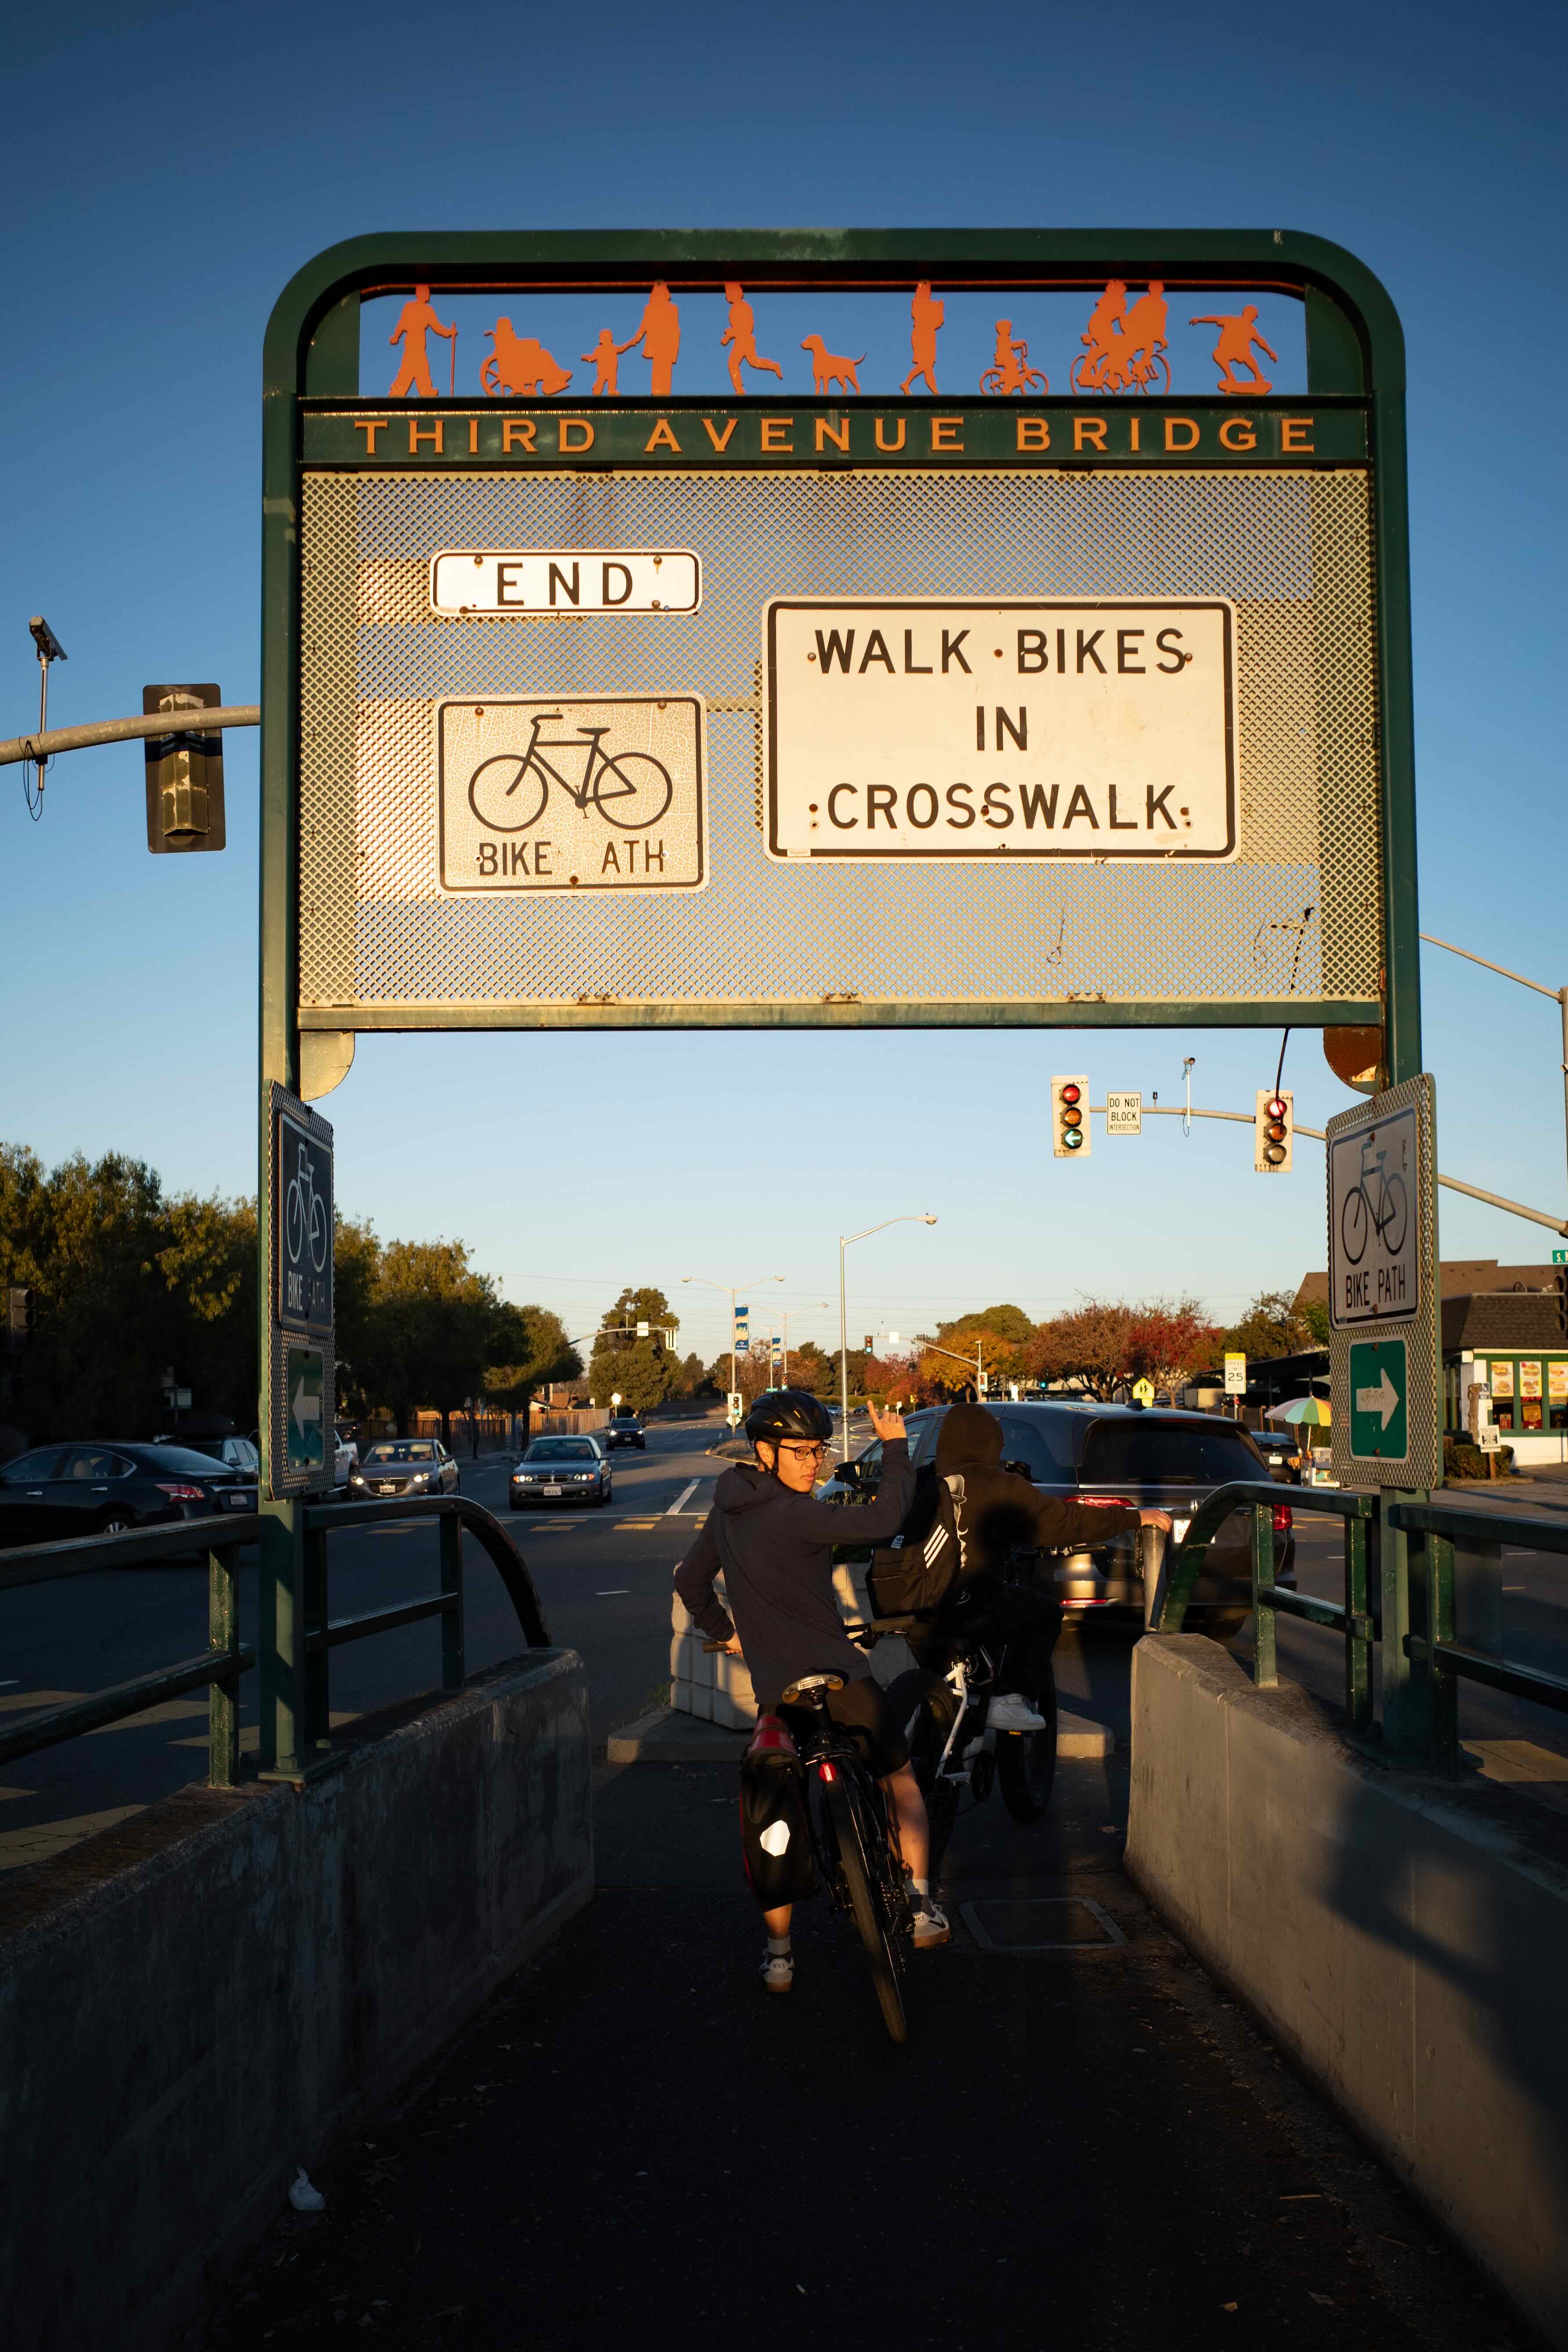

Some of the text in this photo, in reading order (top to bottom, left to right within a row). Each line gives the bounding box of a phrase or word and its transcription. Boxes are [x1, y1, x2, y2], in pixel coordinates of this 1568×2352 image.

[354, 417, 1315, 454] THIRD AVENUE BRIDGE
[497, 562, 633, 605] END
[815, 628, 1185, 674] WALK BIKES
[976, 705, 1027, 751] IN
[828, 783, 1177, 830] CROSSWALK
[479, 841, 553, 876] BIKE
[1109, 1098, 1139, 1107] DO NOT
[1111, 1112, 1137, 1121] BLOCK
[288, 1270, 303, 1311] BIKE
[1346, 1263, 1405, 1308] BIKE PATH
[1228, 1372, 1243, 1381] 25
